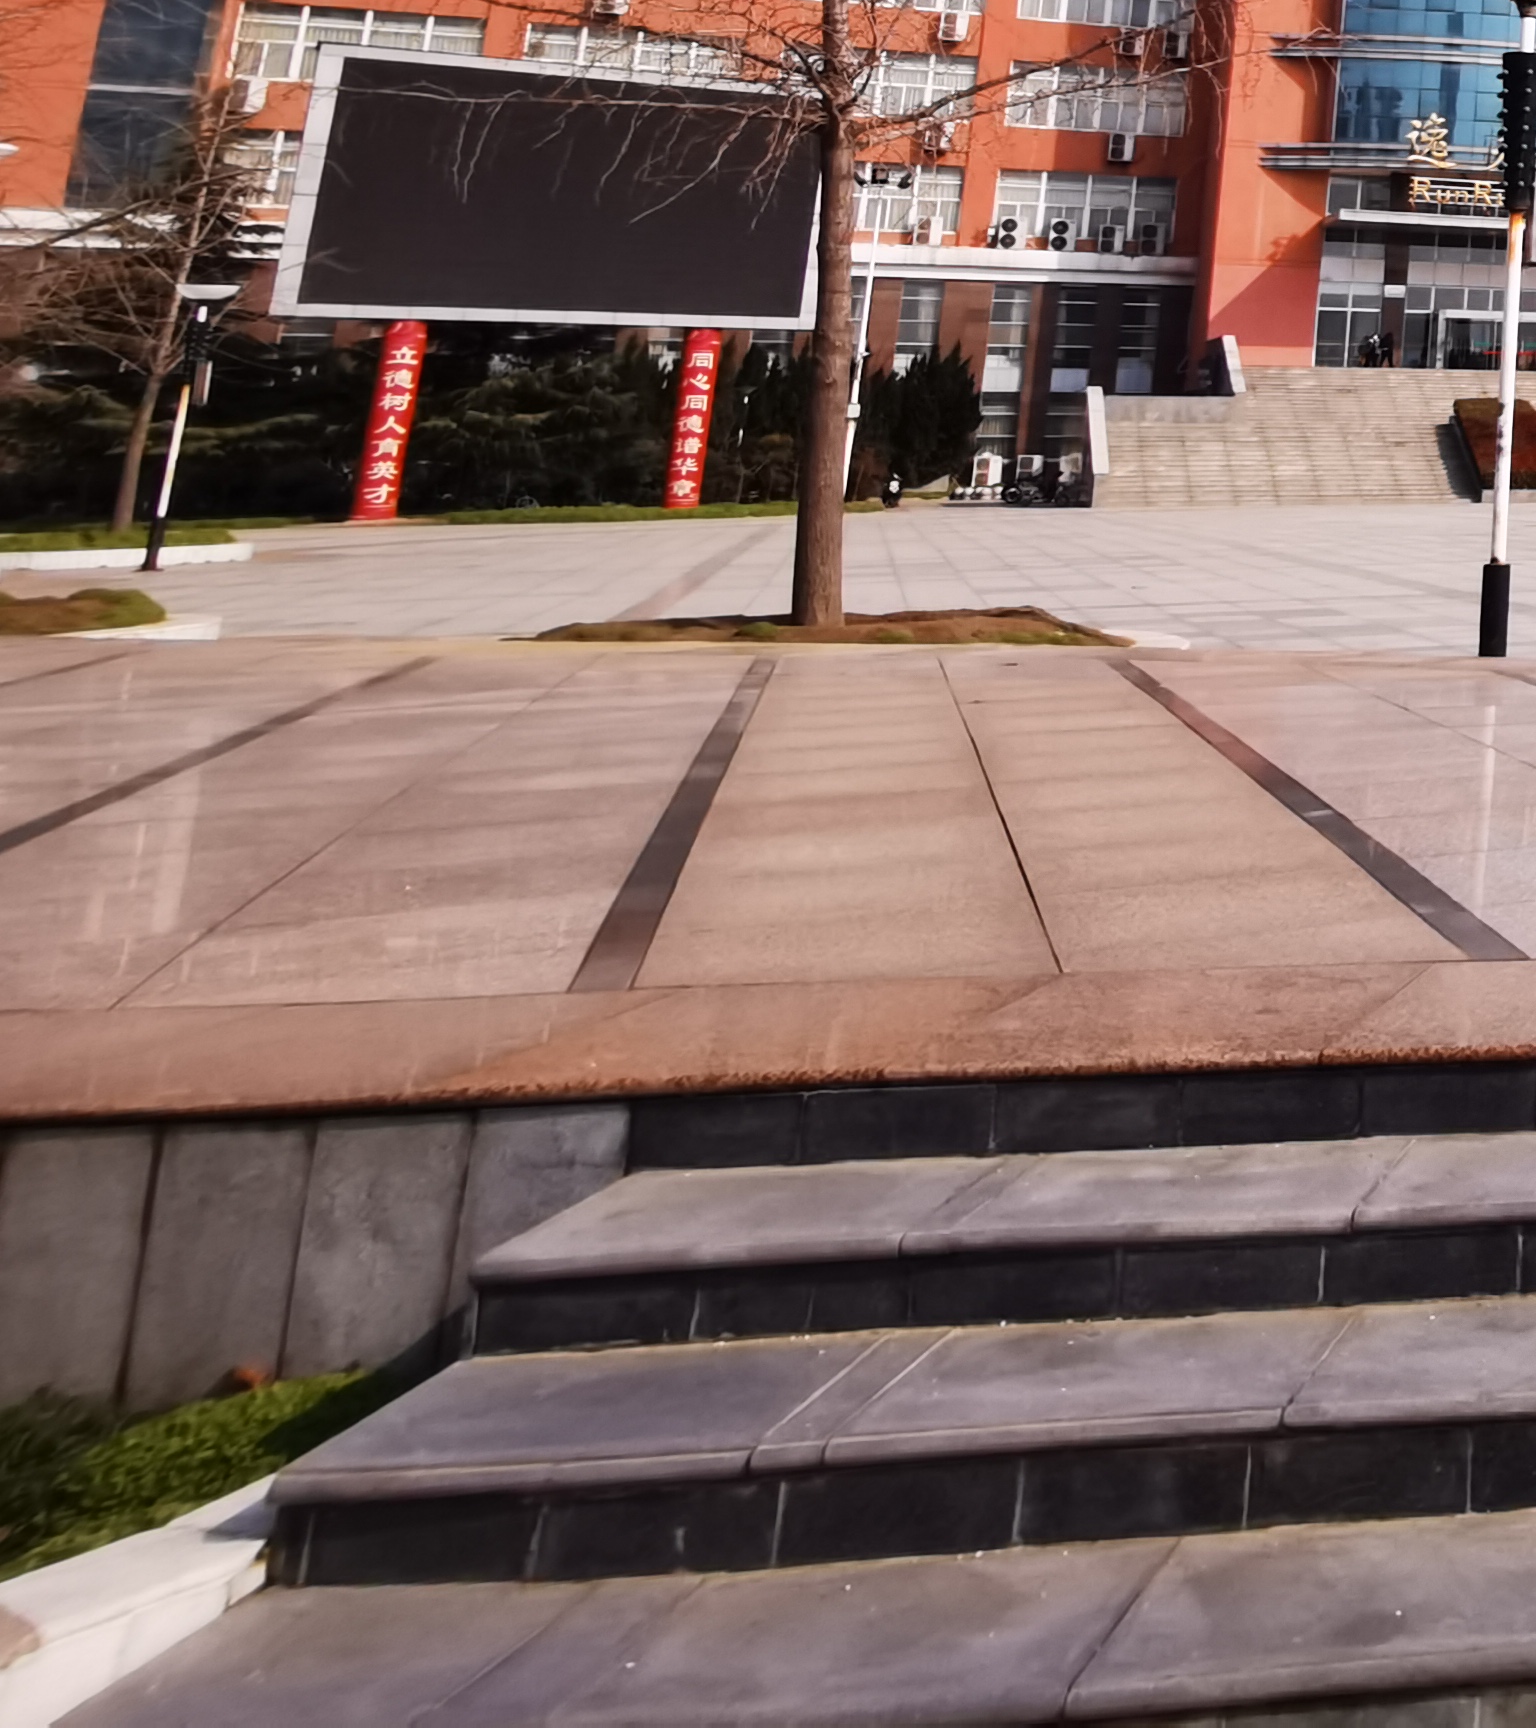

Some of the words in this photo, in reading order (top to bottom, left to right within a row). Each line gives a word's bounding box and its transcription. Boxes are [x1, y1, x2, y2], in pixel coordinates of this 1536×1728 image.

[362, 346, 419, 504] 立德树人育英才
[668, 351, 715, 497] 同心同德谱华章
